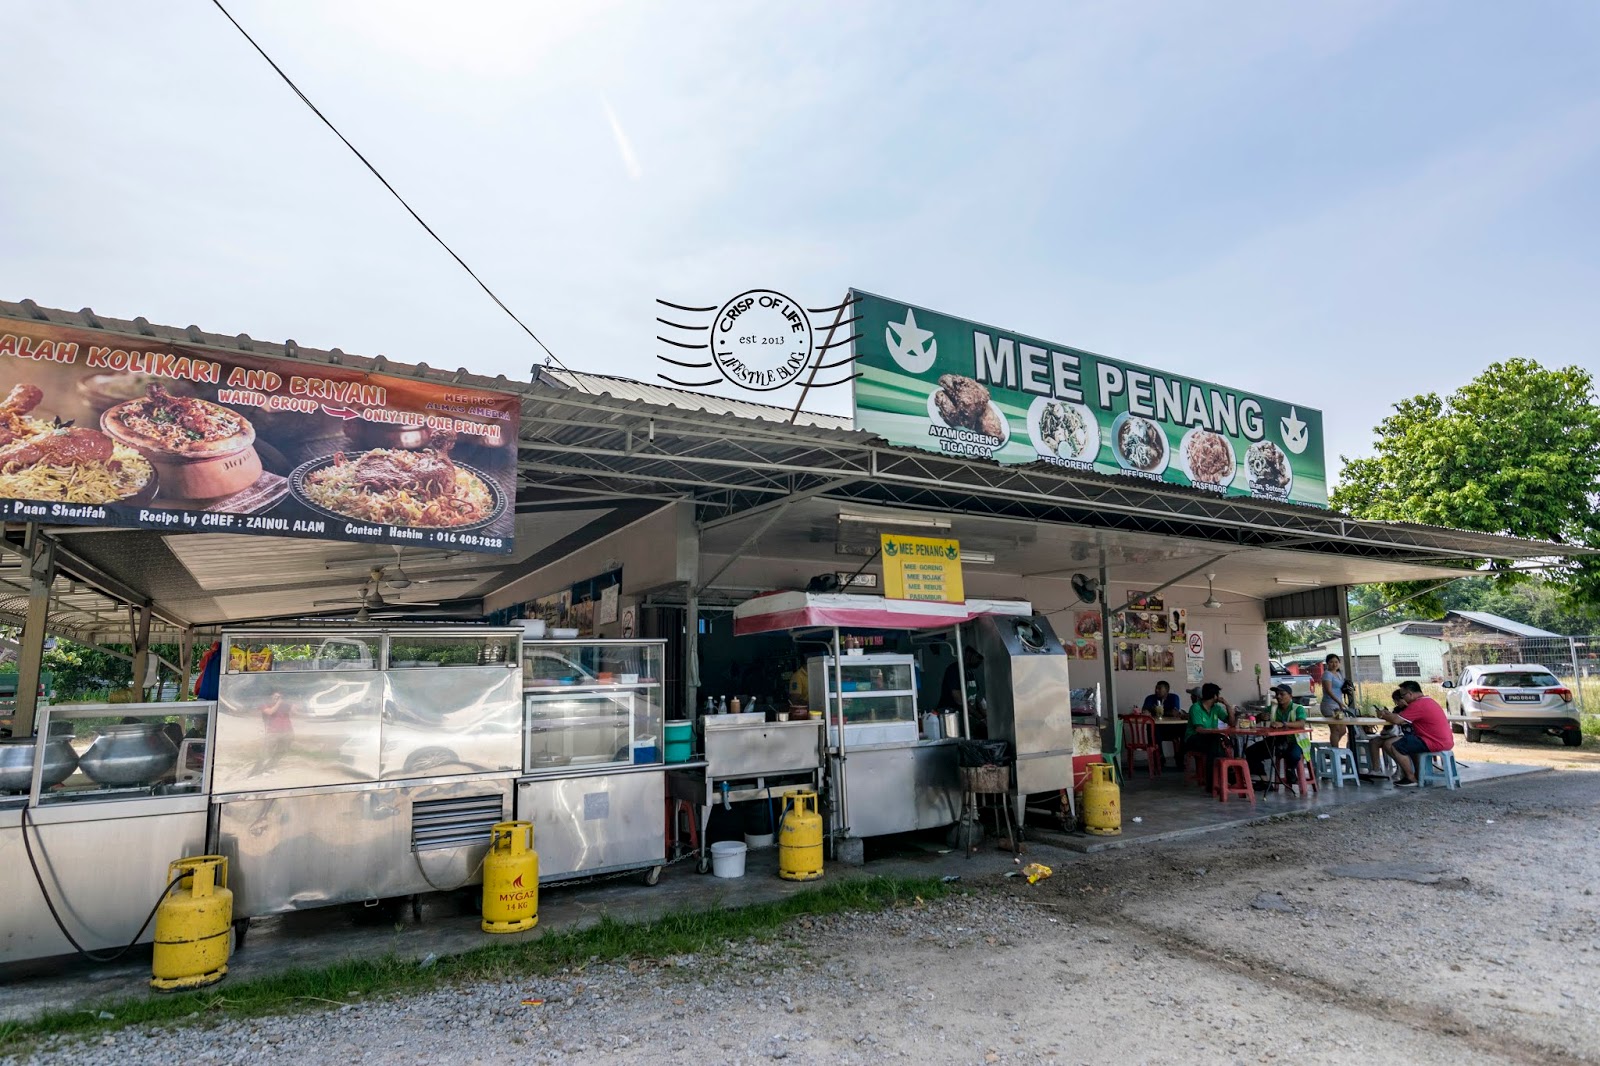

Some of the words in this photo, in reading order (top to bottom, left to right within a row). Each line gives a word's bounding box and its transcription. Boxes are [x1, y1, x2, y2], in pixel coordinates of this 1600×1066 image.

[86, 346, 221, 384] KOLIKARI
[227, 367, 282, 391] AND
[290, 376, 386, 406] BRIYANI
[973, 331, 1085, 404] MEE
[1096, 361, 1265, 441] PENANG
[218, 389, 266, 408] WAHID
[270, 395, 318, 414] GROUP
[425, 401, 465, 413] ALMAS
[445, 393, 468, 403] MEE
[363, 408, 397, 423] ONLY
[399, 411, 424, 426] THE
[427, 415, 453, 430] ONE
[455, 420, 501, 438] BRIYANI
[929, 425, 957, 439] AYAM
[958, 430, 1000, 446] GORENG
[940, 440, 965, 454] TIGA
[966, 444, 993, 458] RASA
[1058, 458, 1093, 471] GORENG
[14, 501, 46, 515] Puan
[51, 504, 106, 518] Sharifah
[140, 509, 179, 523] Recipe
[183, 512, 197, 526] by
[201, 513, 234, 526] CHEF
[246, 517, 289, 530] ZAINUL
[293, 520, 325, 532] ALAM
[345, 523, 382, 536] Contact
[390, 526, 423, 539] Hashim
[437, 532, 456, 543] 016
[459, 534, 503, 548] 408-7828
[899, 542, 914, 555] MEE
[915, 543, 944, 557] PENANG
[499, 890, 534, 901] MYGAZ
